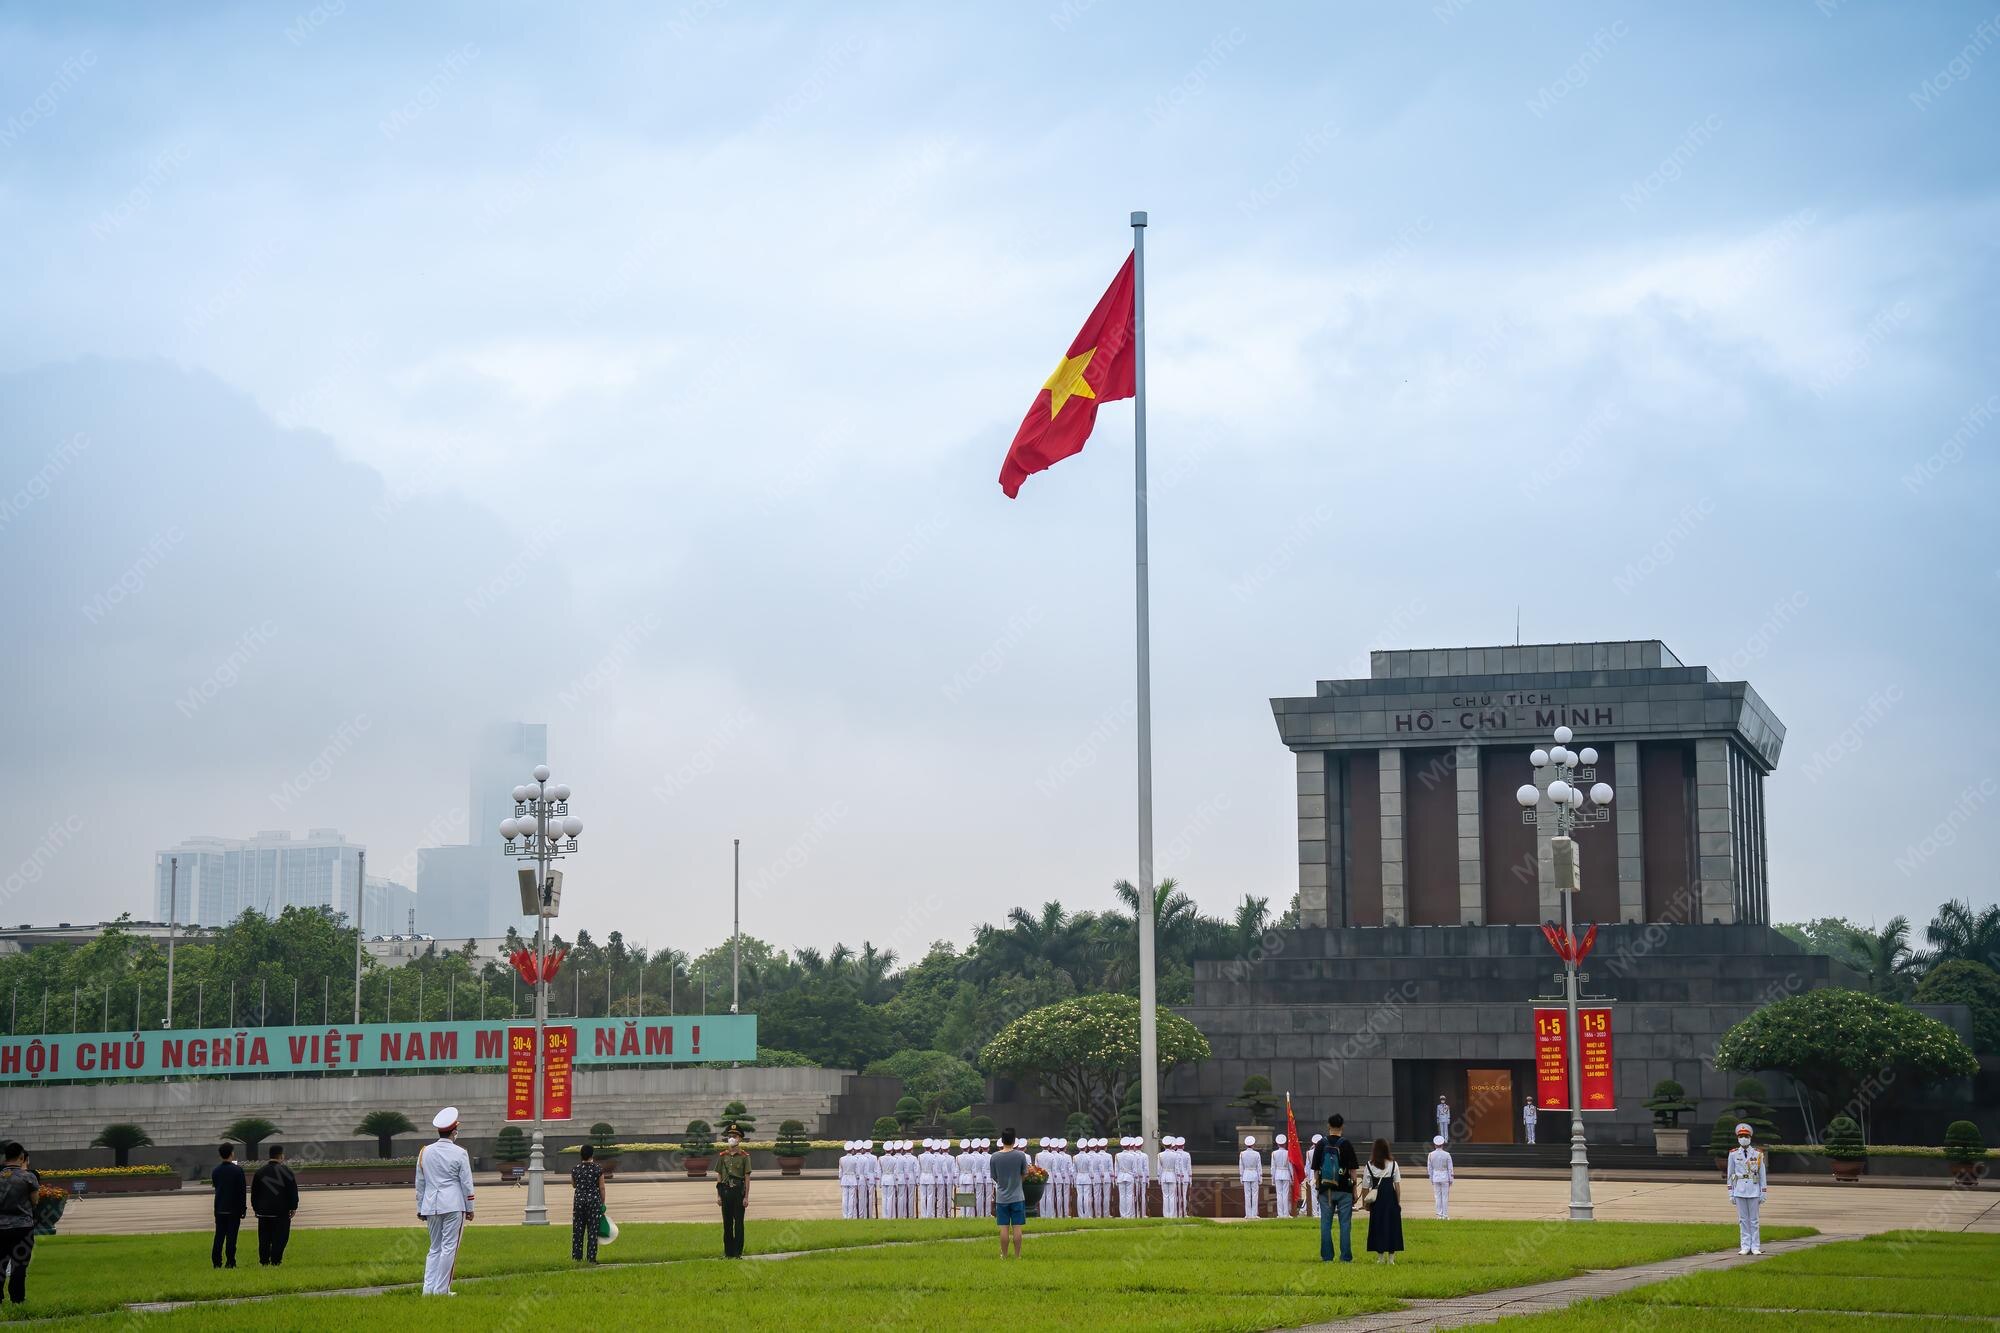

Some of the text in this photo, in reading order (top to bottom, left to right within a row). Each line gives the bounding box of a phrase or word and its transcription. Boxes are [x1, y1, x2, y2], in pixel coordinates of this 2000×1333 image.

[1539, 1018, 1561, 1035] 1-5
[1584, 1014, 1606, 1031] 1-5
[1, 1039, 59, 1078] HỘI
[76, 1033, 145, 1071] CHỦ
[161, 1032, 269, 1069] NGHĨA
[288, 1029, 363, 1068] VIỆT
[380, 1031, 458, 1062] NAM
[595, 1020, 673, 1056] NĂM
[513, 1036, 532, 1051] 30-4
[549, 1033, 568, 1048] 30-4
